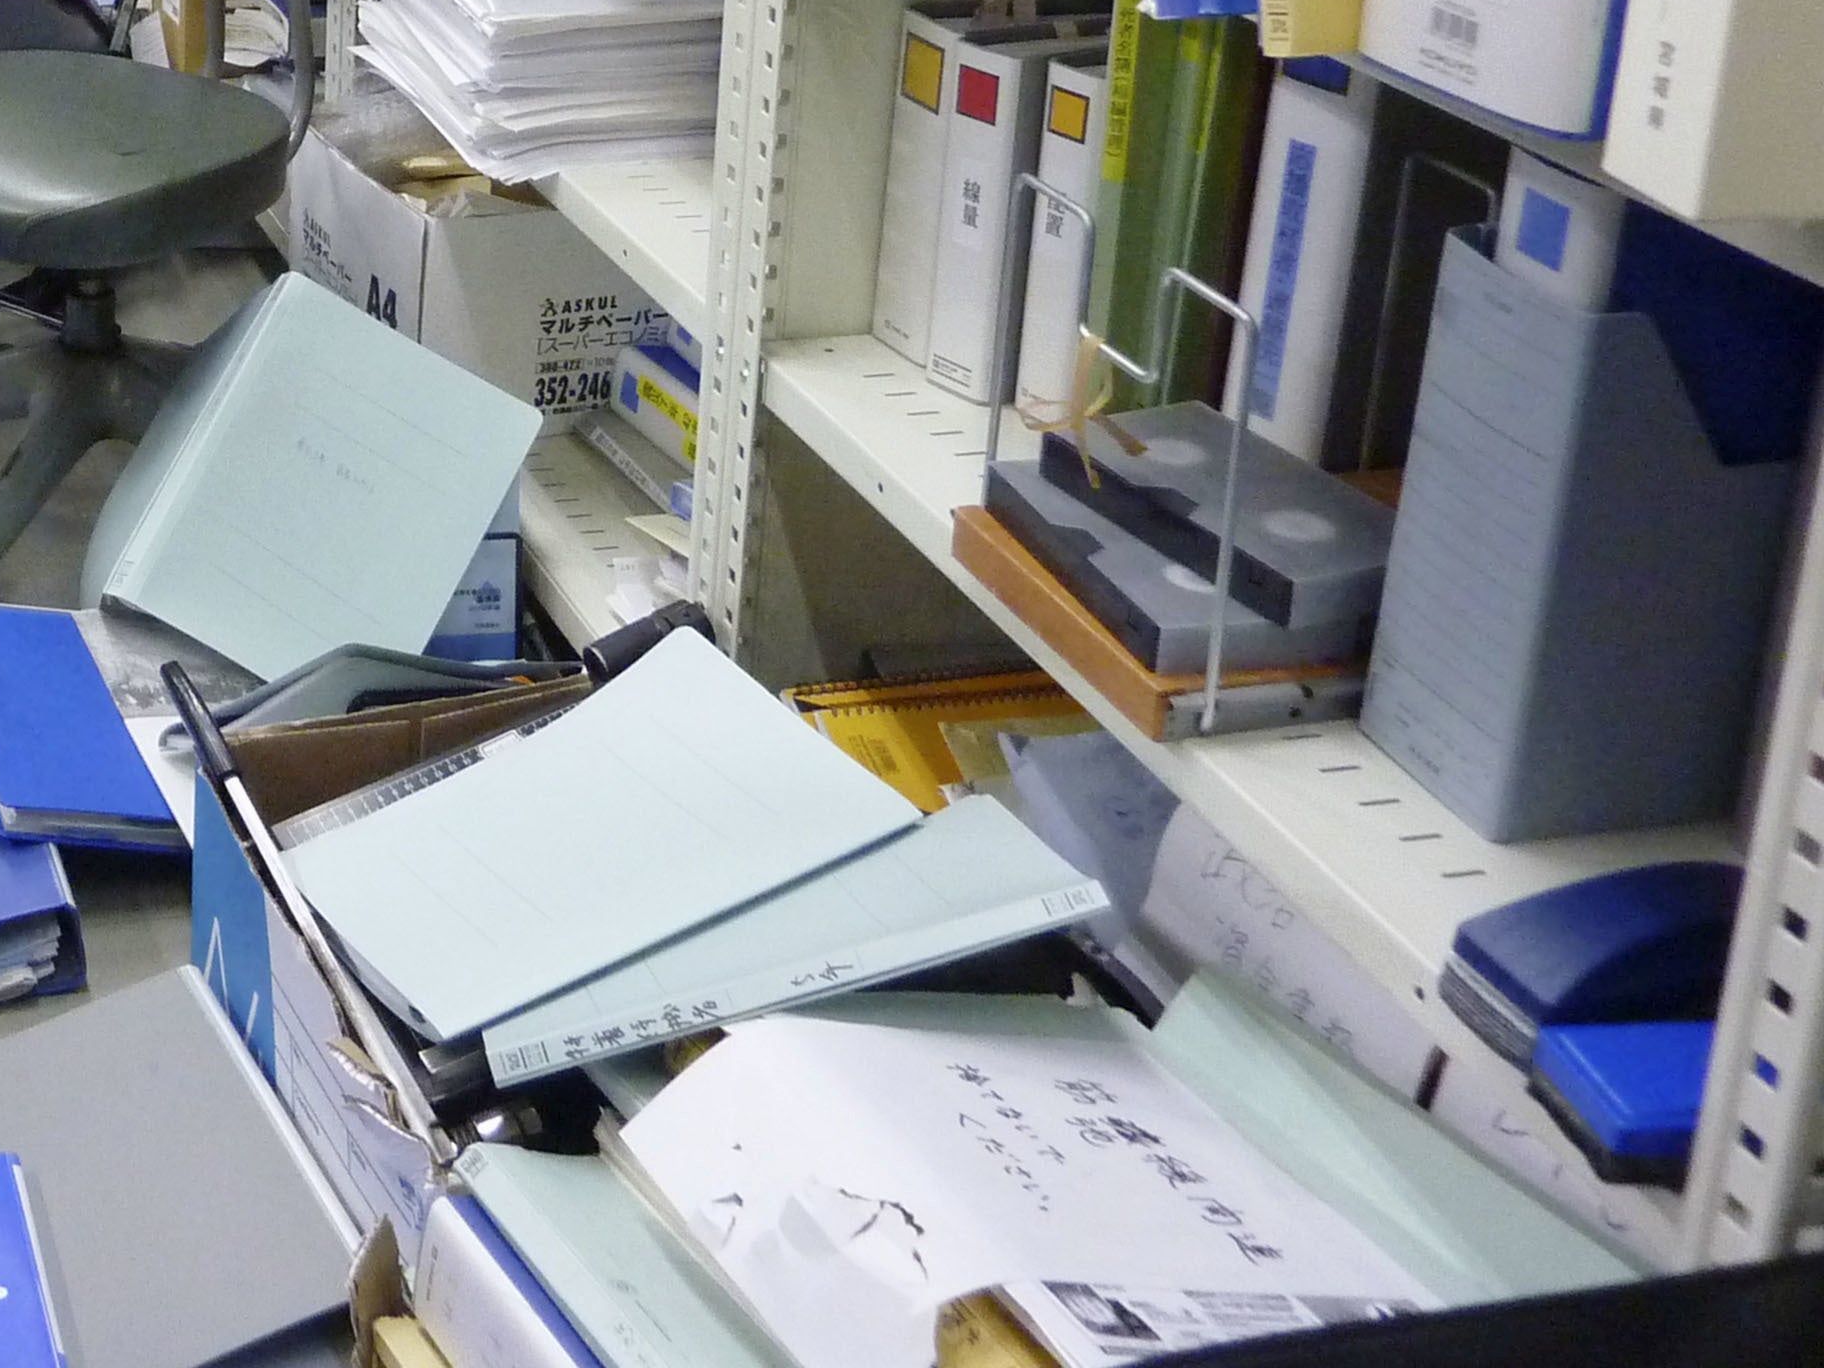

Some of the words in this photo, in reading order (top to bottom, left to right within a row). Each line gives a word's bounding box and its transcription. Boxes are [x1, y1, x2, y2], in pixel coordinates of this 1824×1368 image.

[960, 177, 982, 230] 線量
[302, 227, 353, 283] マルチペーパー
[365, 272, 398, 329] A4
[539, 308, 670, 334] マルチペーパー
[561, 295, 619, 313] ASKUL
[946, 1060, 1067, 1169] 捨てないで
[958, 1110, 1052, 1214] ください
